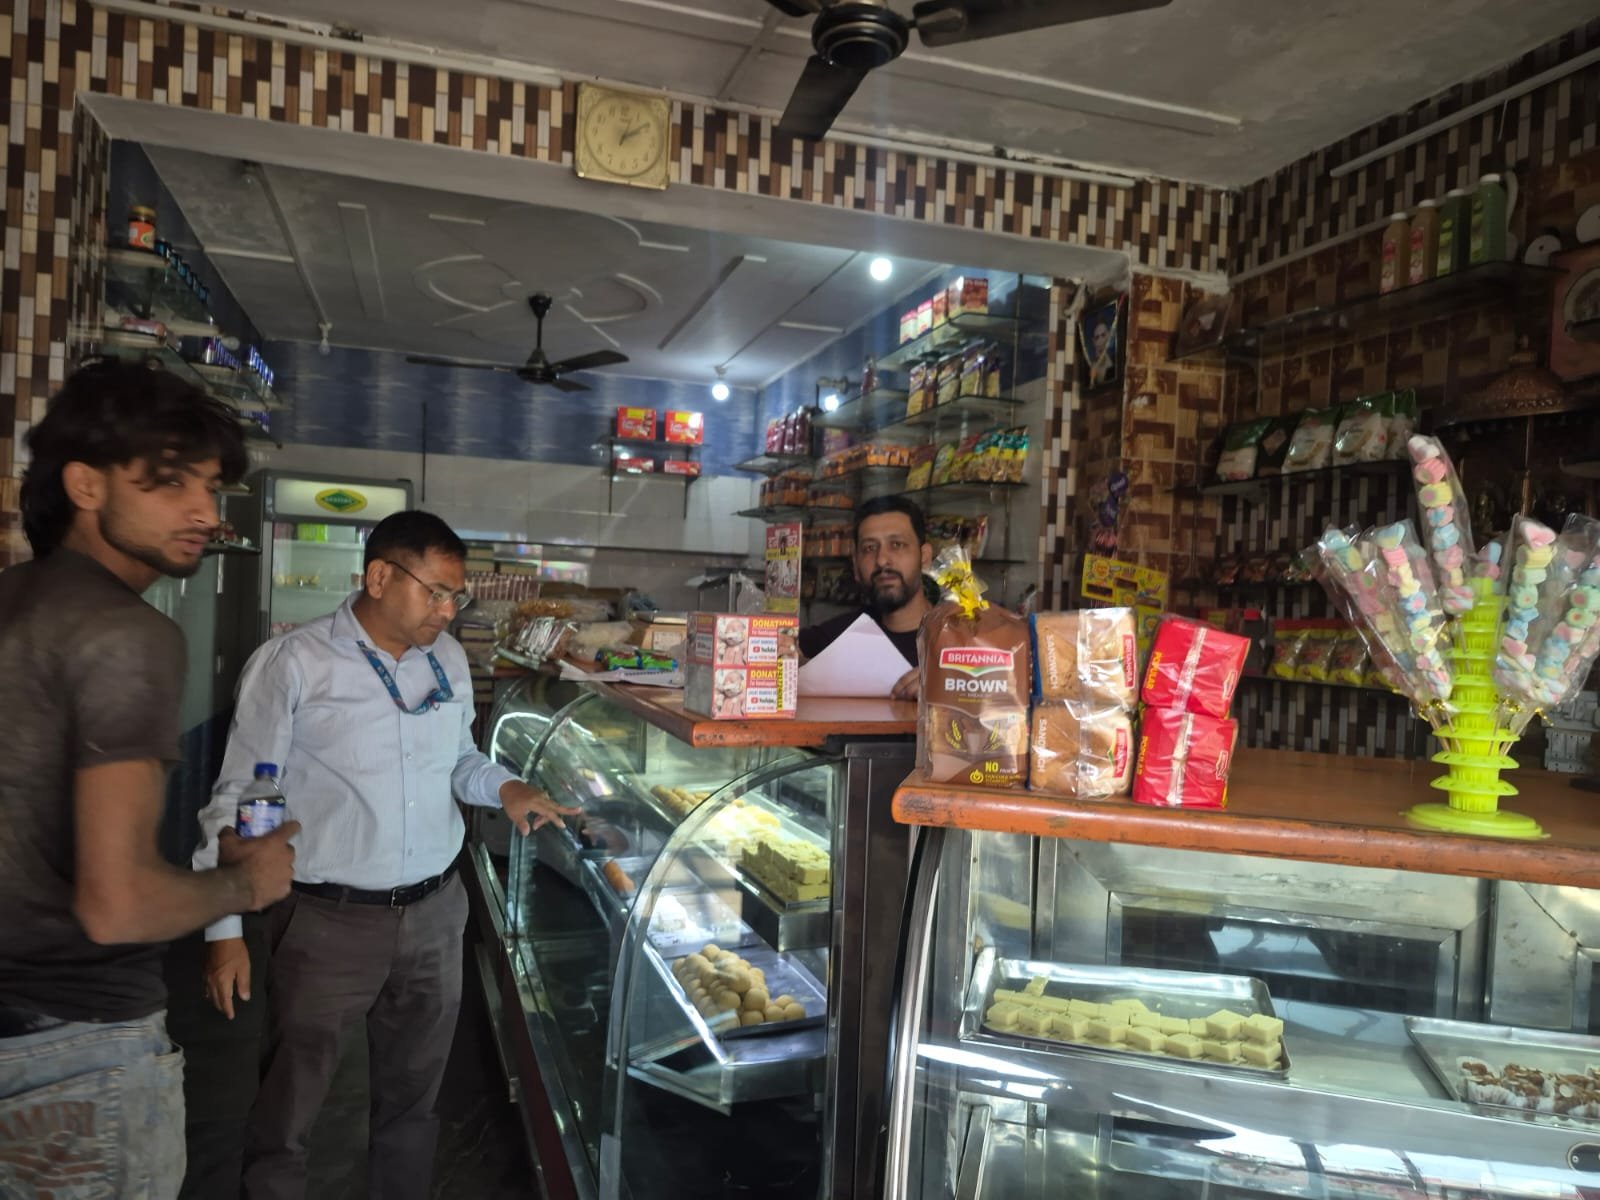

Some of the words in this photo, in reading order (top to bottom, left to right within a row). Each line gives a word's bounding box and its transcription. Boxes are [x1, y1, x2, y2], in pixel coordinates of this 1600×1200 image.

[752, 618, 794, 628] DONATION
[947, 652, 1006, 665] BRITANNIA
[944, 678, 1008, 693] BROWN
[1037, 718, 1048, 773] SANDCH
[985, 761, 999, 773] NO
